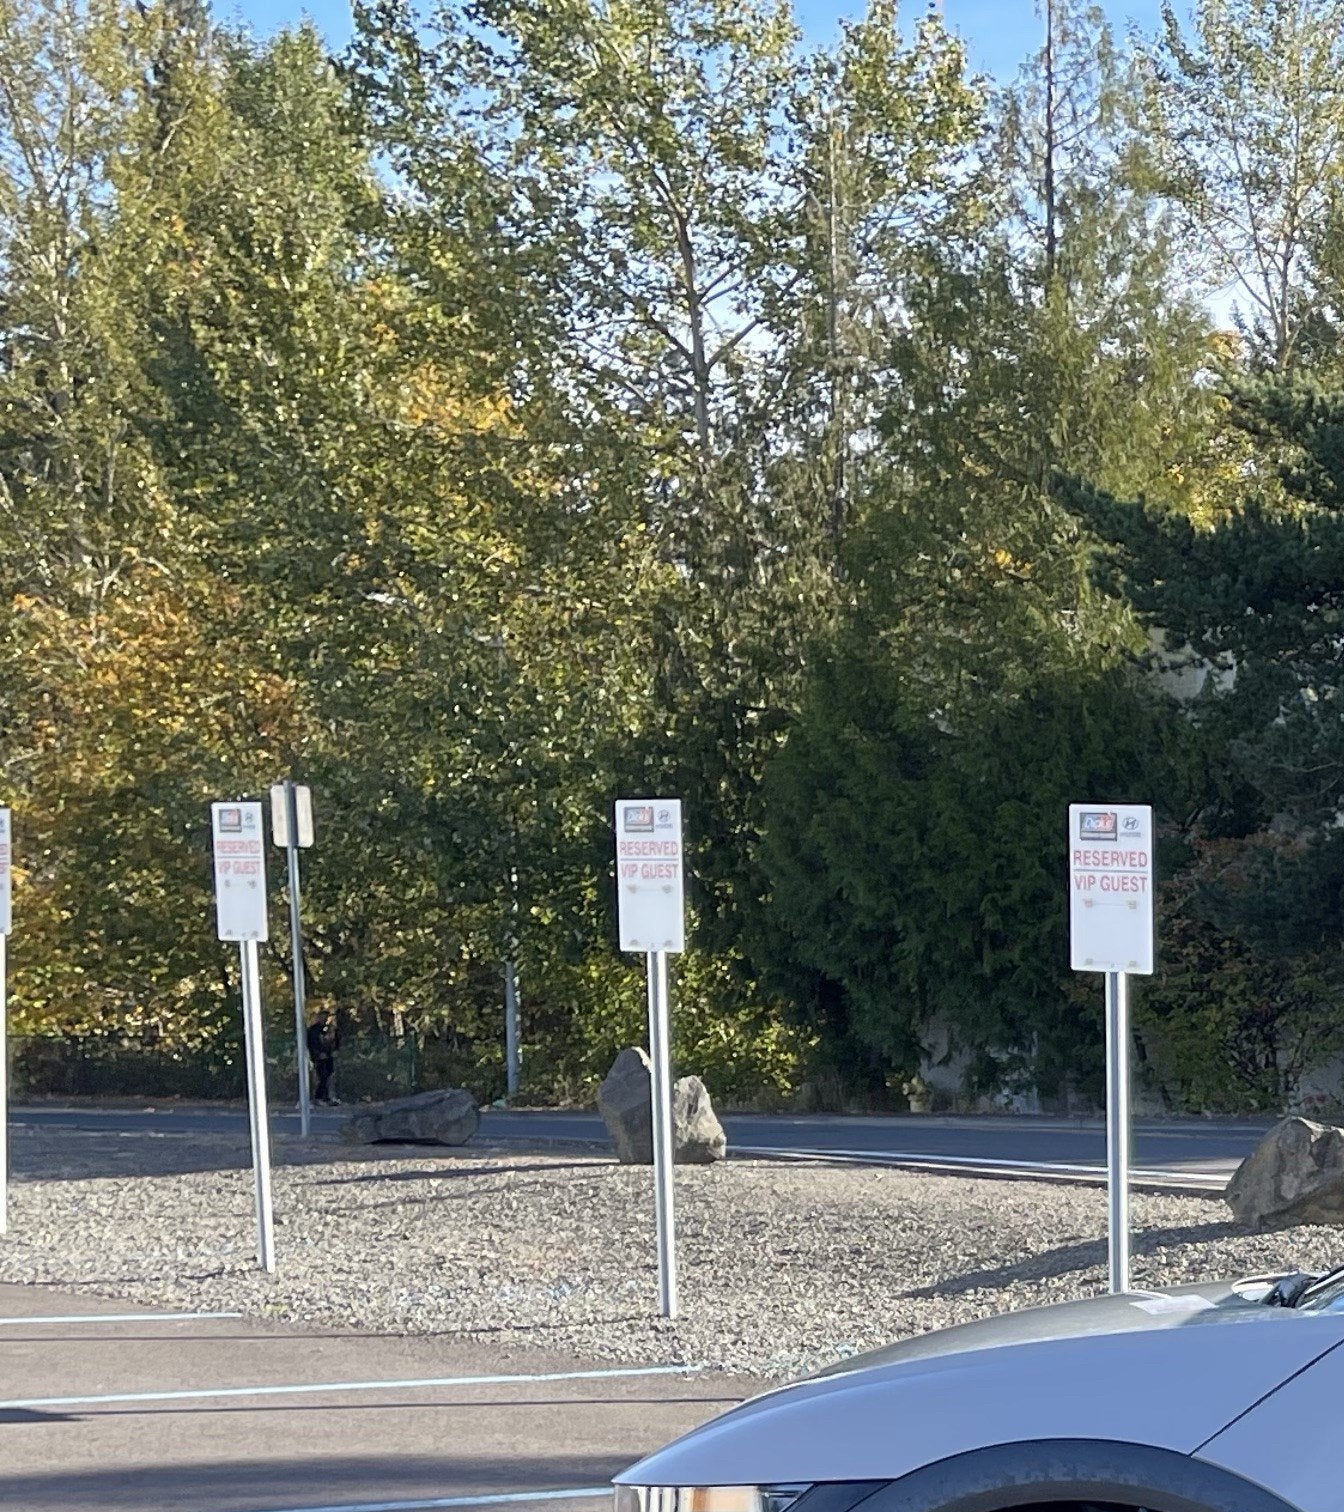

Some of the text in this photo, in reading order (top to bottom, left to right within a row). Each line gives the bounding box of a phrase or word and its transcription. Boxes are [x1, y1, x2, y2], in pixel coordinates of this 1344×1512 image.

[619, 841, 678, 856] RESERVED
[1073, 850, 1148, 868] RESERVED
[621, 863, 679, 879] VIP GUEST
[1073, 874, 1148, 893] VIP GUEST
